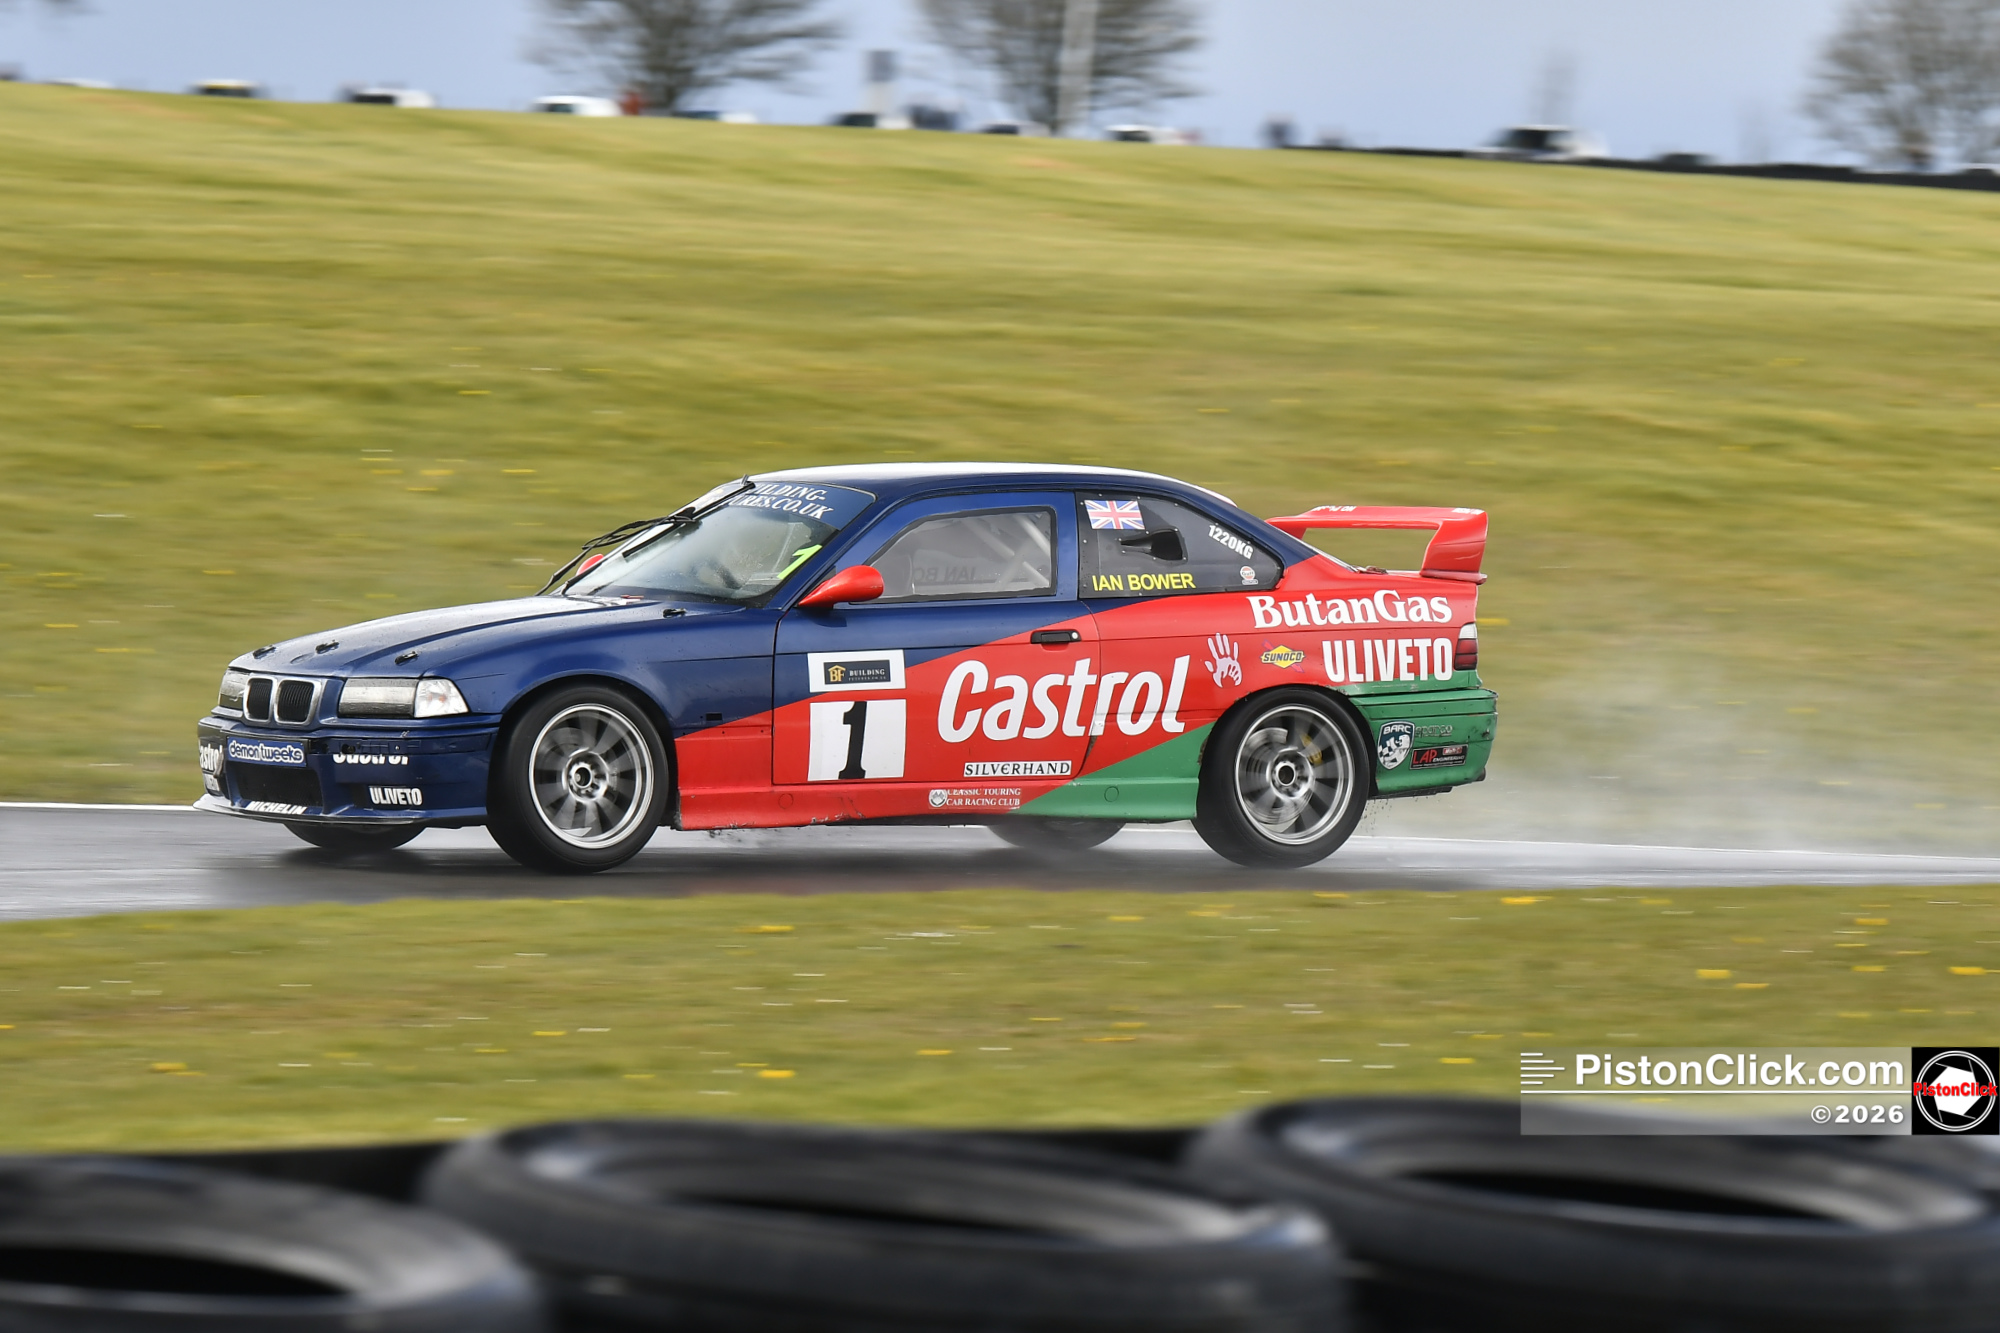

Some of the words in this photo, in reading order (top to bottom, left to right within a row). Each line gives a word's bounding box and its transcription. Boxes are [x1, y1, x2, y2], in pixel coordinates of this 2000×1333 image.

[745, 484, 828, 501] UILDING-
[728, 495, 834, 519] URES.CO.UK
[1208, 525, 1253, 559] 1220KG
[776, 544, 822, 579] 1
[1092, 575, 1124, 591] IAN
[1127, 573, 1196, 591] BOWER
[1246, 589, 1453, 628] ButanGas
[1263, 652, 1302, 662] SUNOCO
[1322, 638, 1453, 683] ULIVETO
[829, 669, 845, 682] BF
[937, 654, 1190, 743] Castrol
[1383, 724, 1411, 734] BARC
[838, 701, 867, 779] 1
[1413, 749, 1437, 764] LAP
[965, 762, 1070, 775] SILVERHAND
[370, 787, 423, 806] ULIVETO
[947, 788, 981, 796] CLASSIC
[984, 787, 1021, 796] TOURING
[245, 801, 308, 815] MICHELIN
[946, 798, 963, 806] CAR
[965, 798, 996, 806] RACING
[998, 798, 1020, 806] CLUB
